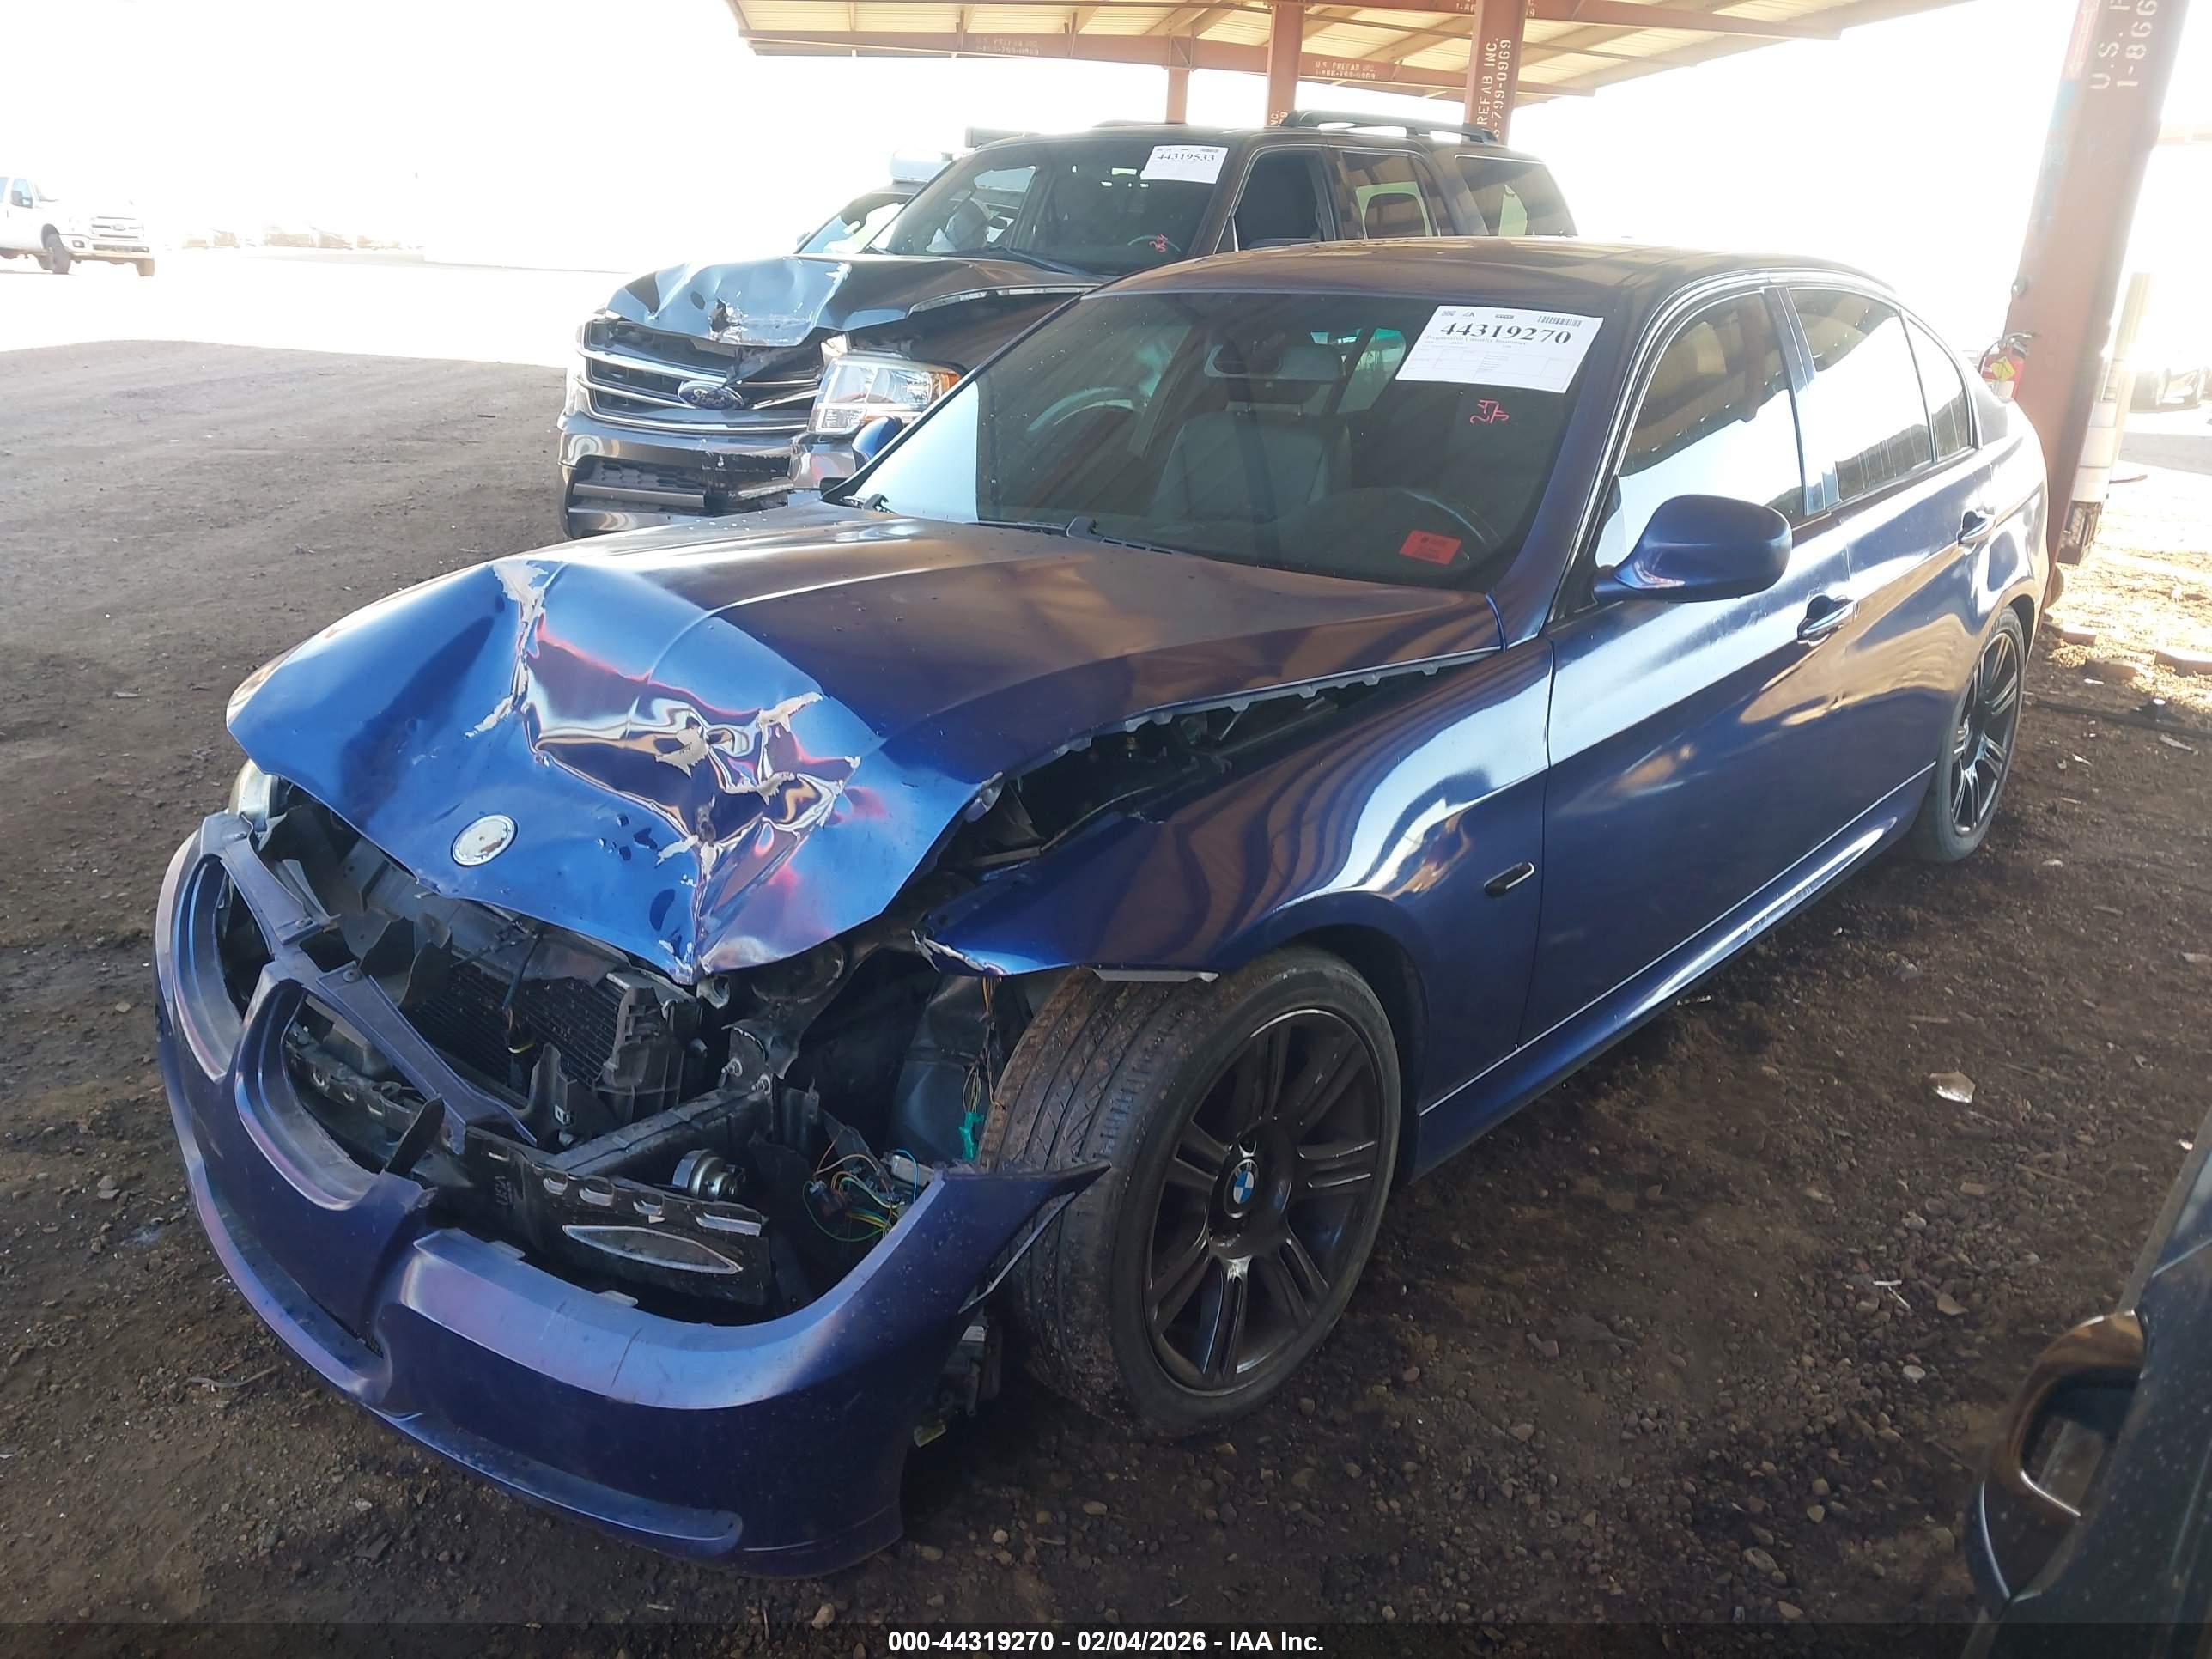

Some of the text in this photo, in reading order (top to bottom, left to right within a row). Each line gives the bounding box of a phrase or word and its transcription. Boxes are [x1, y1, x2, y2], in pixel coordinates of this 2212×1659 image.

[2089, 32, 2124, 89] U.S.
[1476, 37, 1498, 125] REFAB INC.
[1158, 153, 1216, 162] 44319533
[1441, 322, 1571, 344] 44319270
